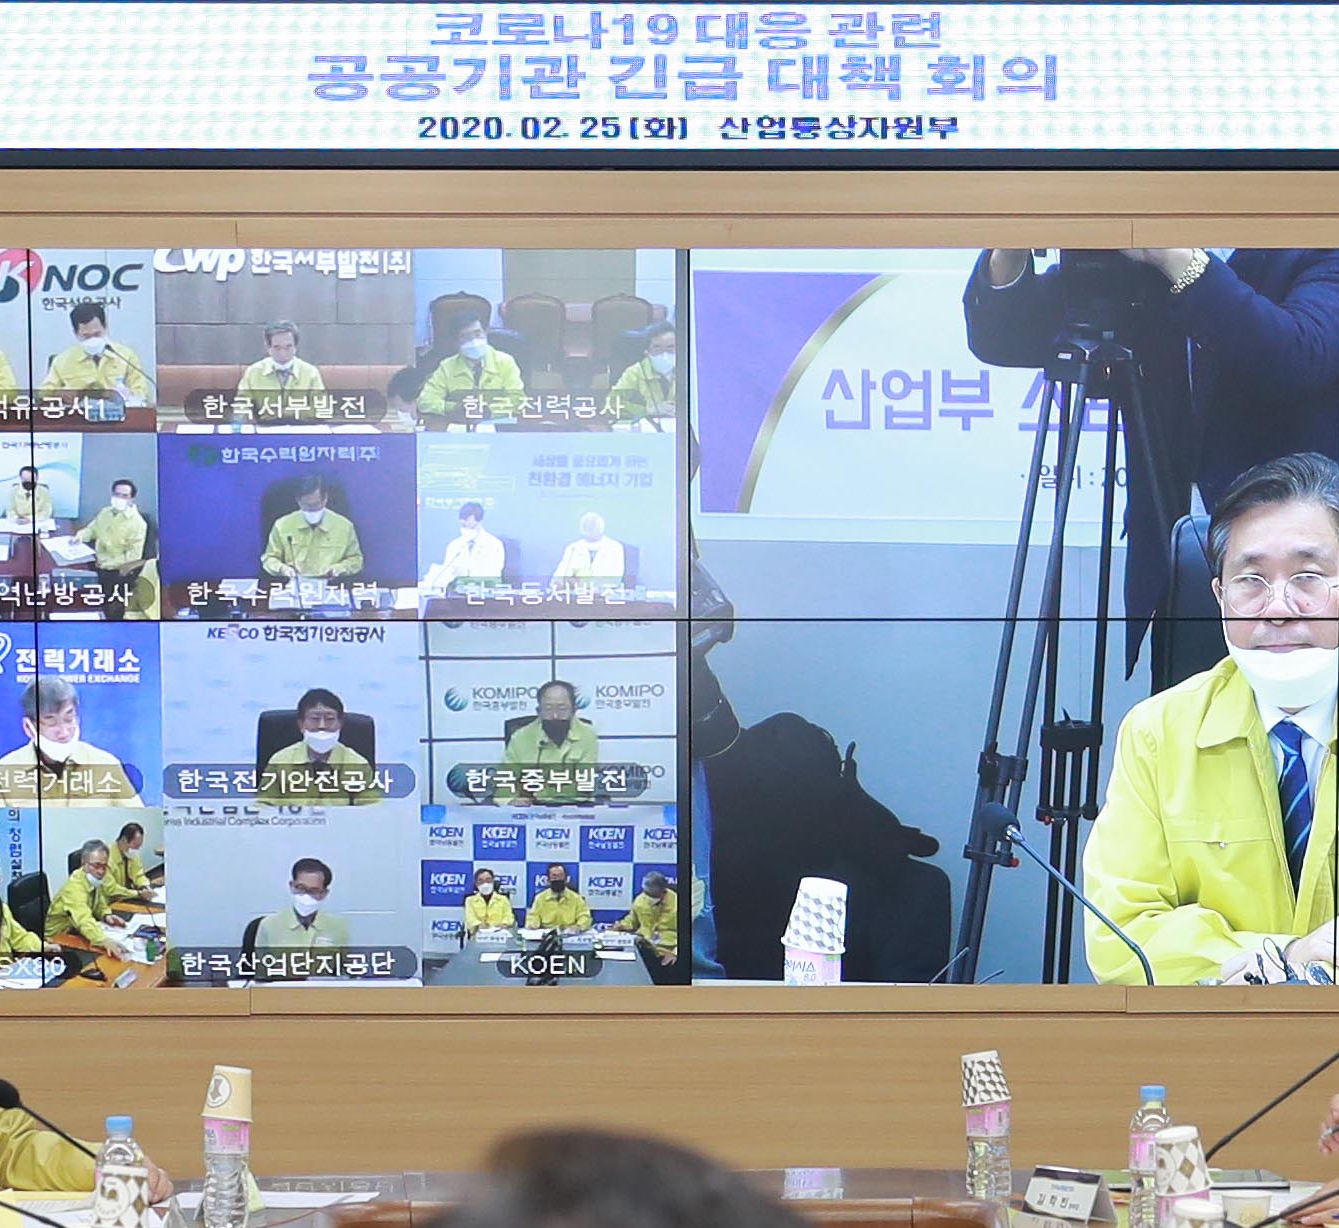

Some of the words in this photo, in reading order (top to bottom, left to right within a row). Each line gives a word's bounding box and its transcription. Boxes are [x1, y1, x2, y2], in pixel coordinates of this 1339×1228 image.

[431, 11, 682, 49] 코로나19
[696, 11, 813, 49] 대응
[829, 11, 943, 49] 관련
[308, 55, 587, 101] 공공기관
[608, 55, 744, 101] 긴급
[767, 55, 901, 101] 대책
[927, 55, 1058, 101] 회의
[718, 114, 959, 141] 산업통상자원부
[202, 394, 367, 420] 한국서부발전
[462, 394, 625, 420] 한국전력공사
[820, 368, 994, 432] 산업부
[187, 582, 378, 609] 한국수력원자력
[263, 625, 385, 643] 한국전기안전공사
[16, 648, 141, 673] 전력거래소
[596, 684, 664, 698] KOMIPO
[178, 769, 394, 794] 한국전기안전공사
[465, 768, 628, 793] 한국중부발전
[181, 952, 396, 977] 한국산업단지공단
[511, 955, 585, 975] KOEN
